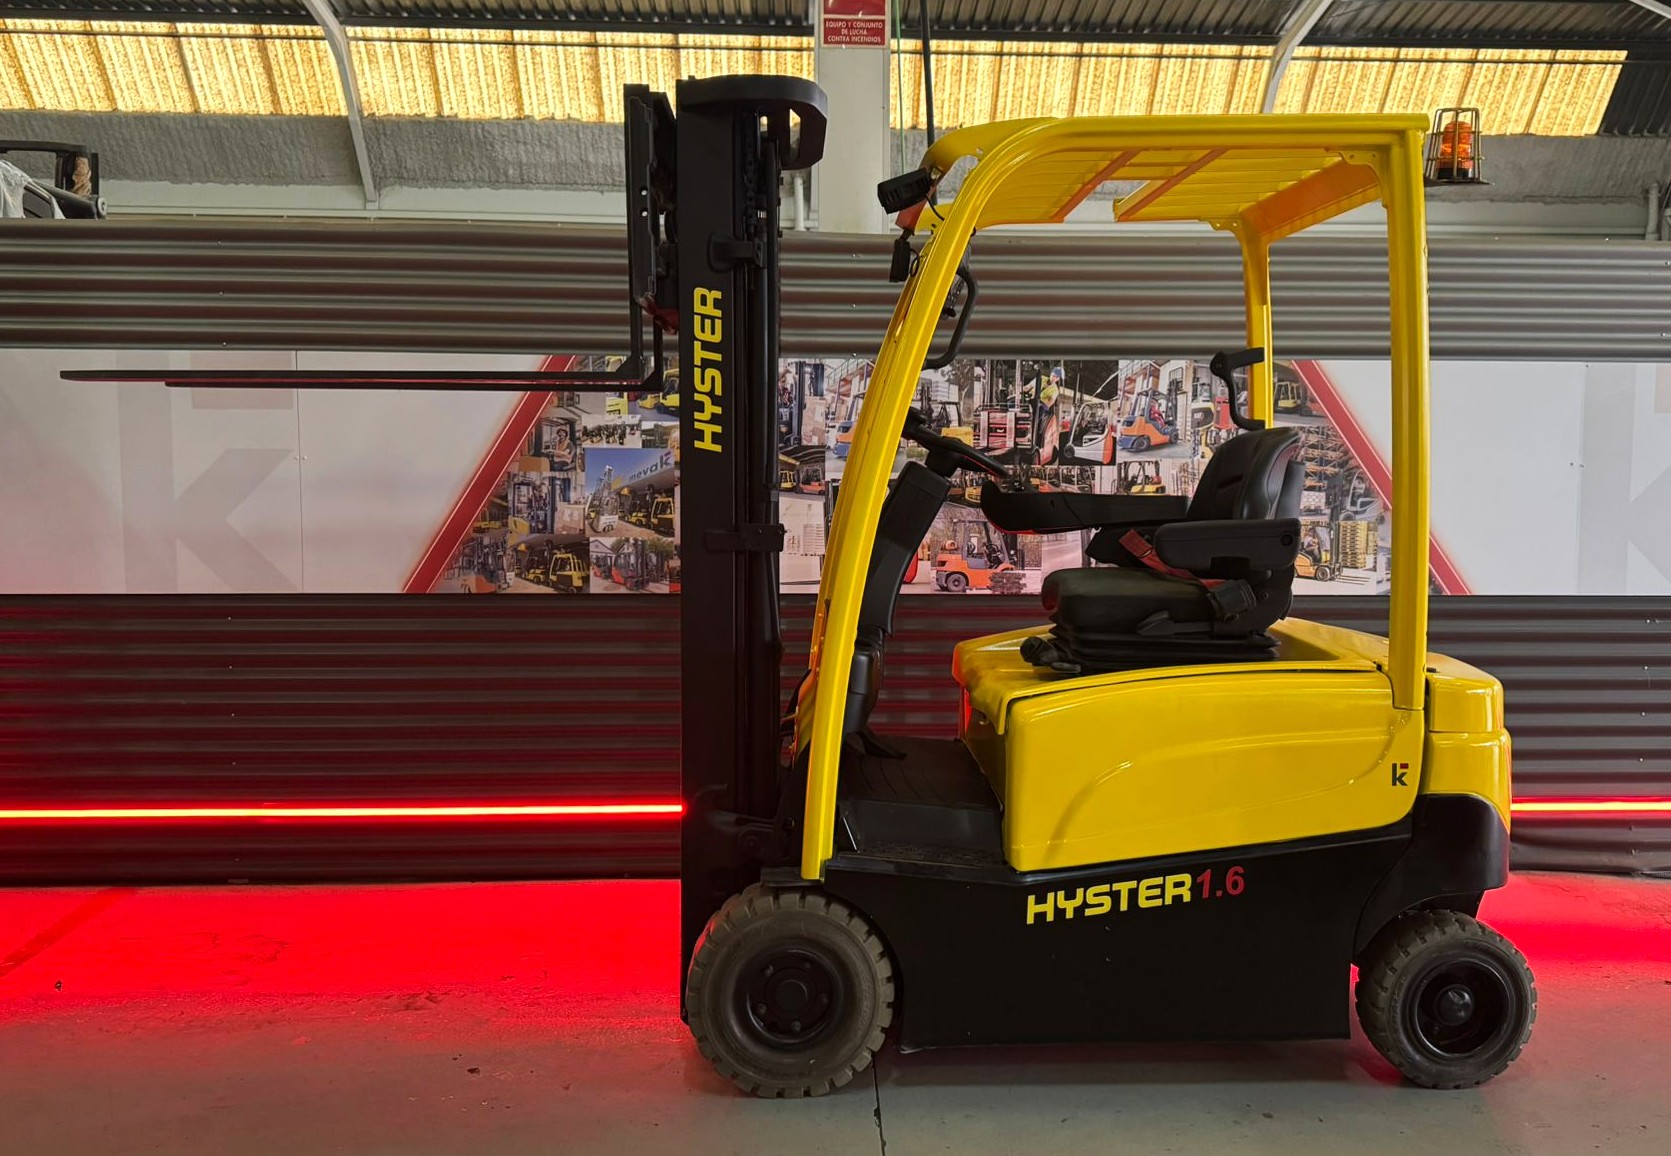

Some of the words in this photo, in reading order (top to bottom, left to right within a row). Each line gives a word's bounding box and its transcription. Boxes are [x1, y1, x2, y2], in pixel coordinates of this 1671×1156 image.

[851, 35, 881, 43] INCENDIOS
[852, 21, 883, 29] CONJUNTO
[693, 287, 723, 453] HYSTER
[628, 451, 672, 483] mevak
[1026, 873, 1192, 925] HYSTER
[1196, 866, 1245, 899] 1.6
